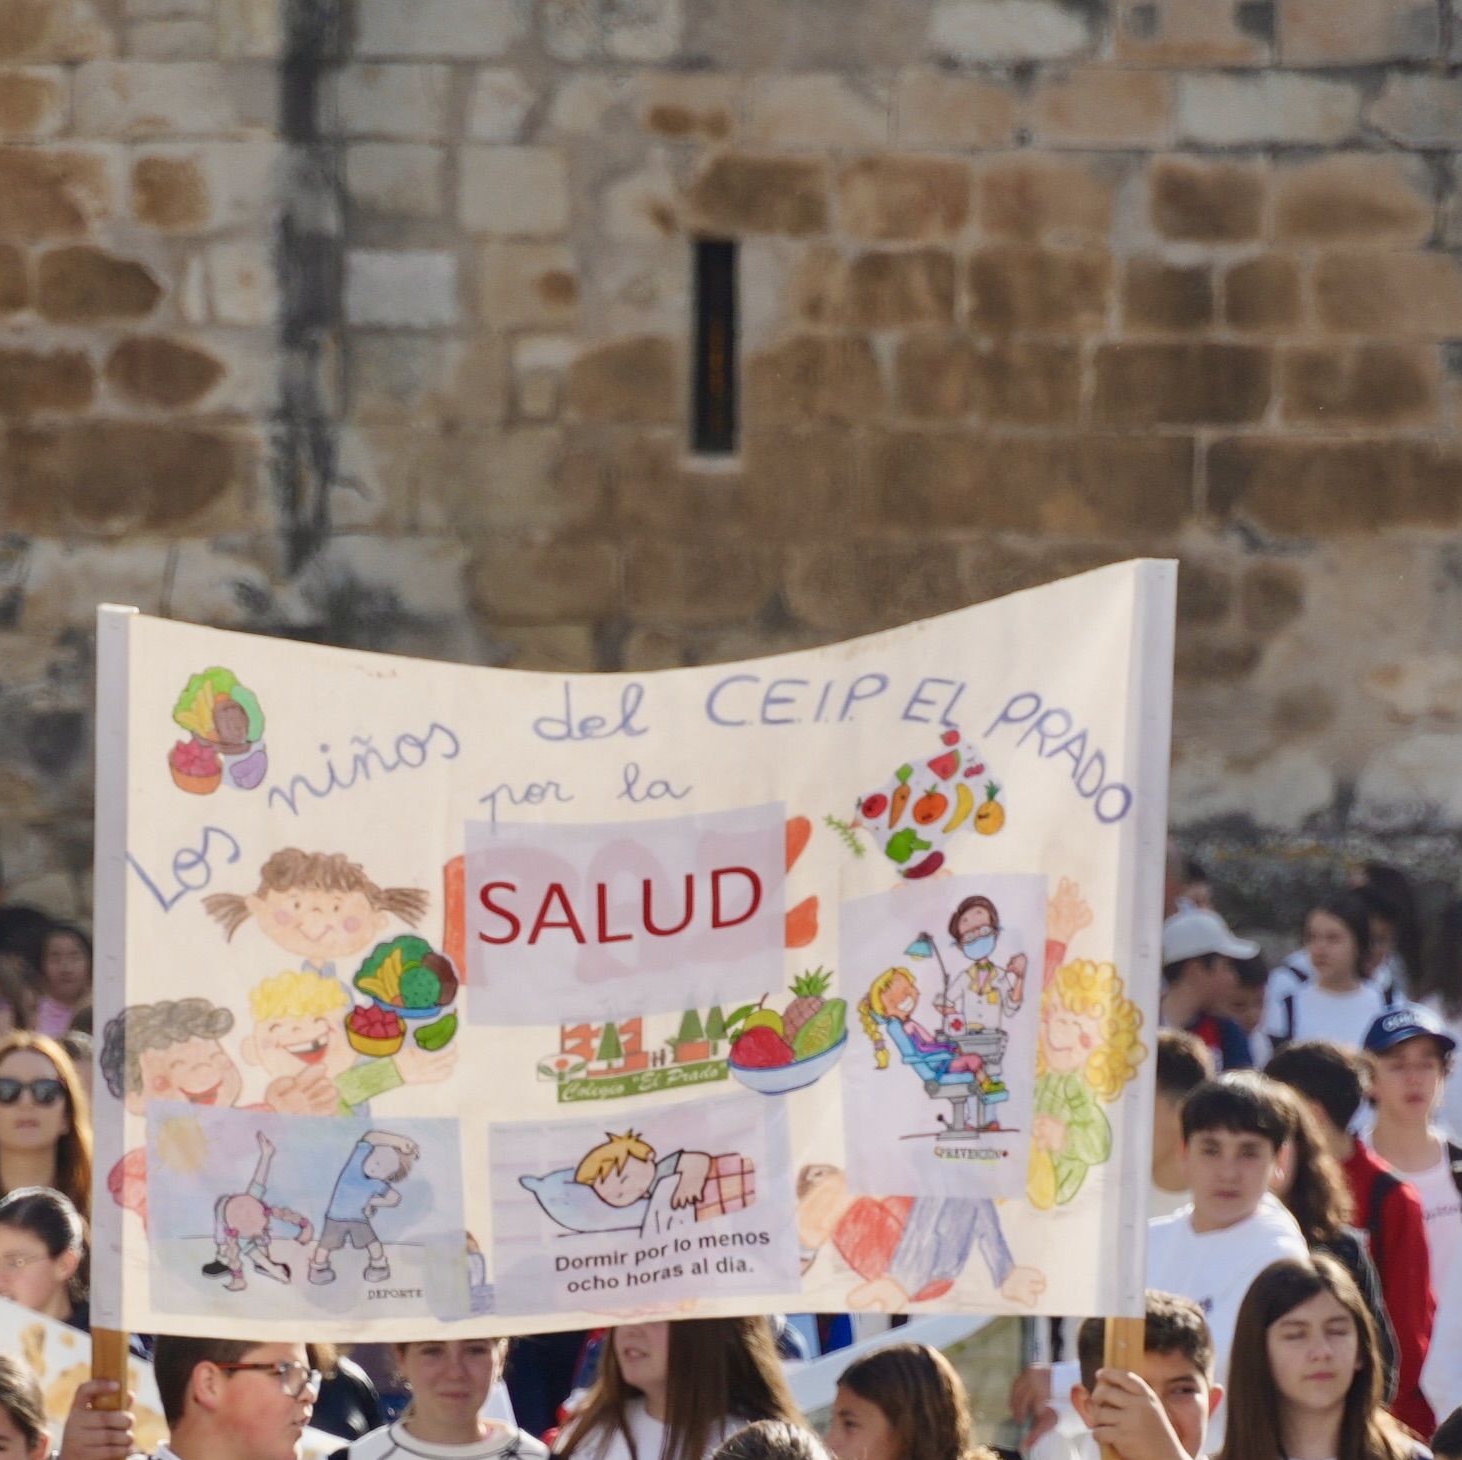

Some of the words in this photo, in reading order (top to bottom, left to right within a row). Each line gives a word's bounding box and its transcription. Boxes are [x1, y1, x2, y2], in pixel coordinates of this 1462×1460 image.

[126, 825, 240, 912] Los
[268, 722, 460, 815] niños
[532, 681, 649, 741] del
[983, 691, 1133, 823] PRADO
[479, 781, 574, 835] por
[617, 762, 693, 803] la
[479, 866, 763, 945] SALUD
[556, 1253, 629, 1272] Dormir
[635, 1245, 669, 1267] por
[674, 1238, 692, 1253] lo
[699, 1230, 771, 1250] menos
[567, 1274, 620, 1294] ocho
[627, 1263, 684, 1287] horas
[691, 1257, 709, 1275] al
[368, 1289, 424, 1300] DEPORTE
